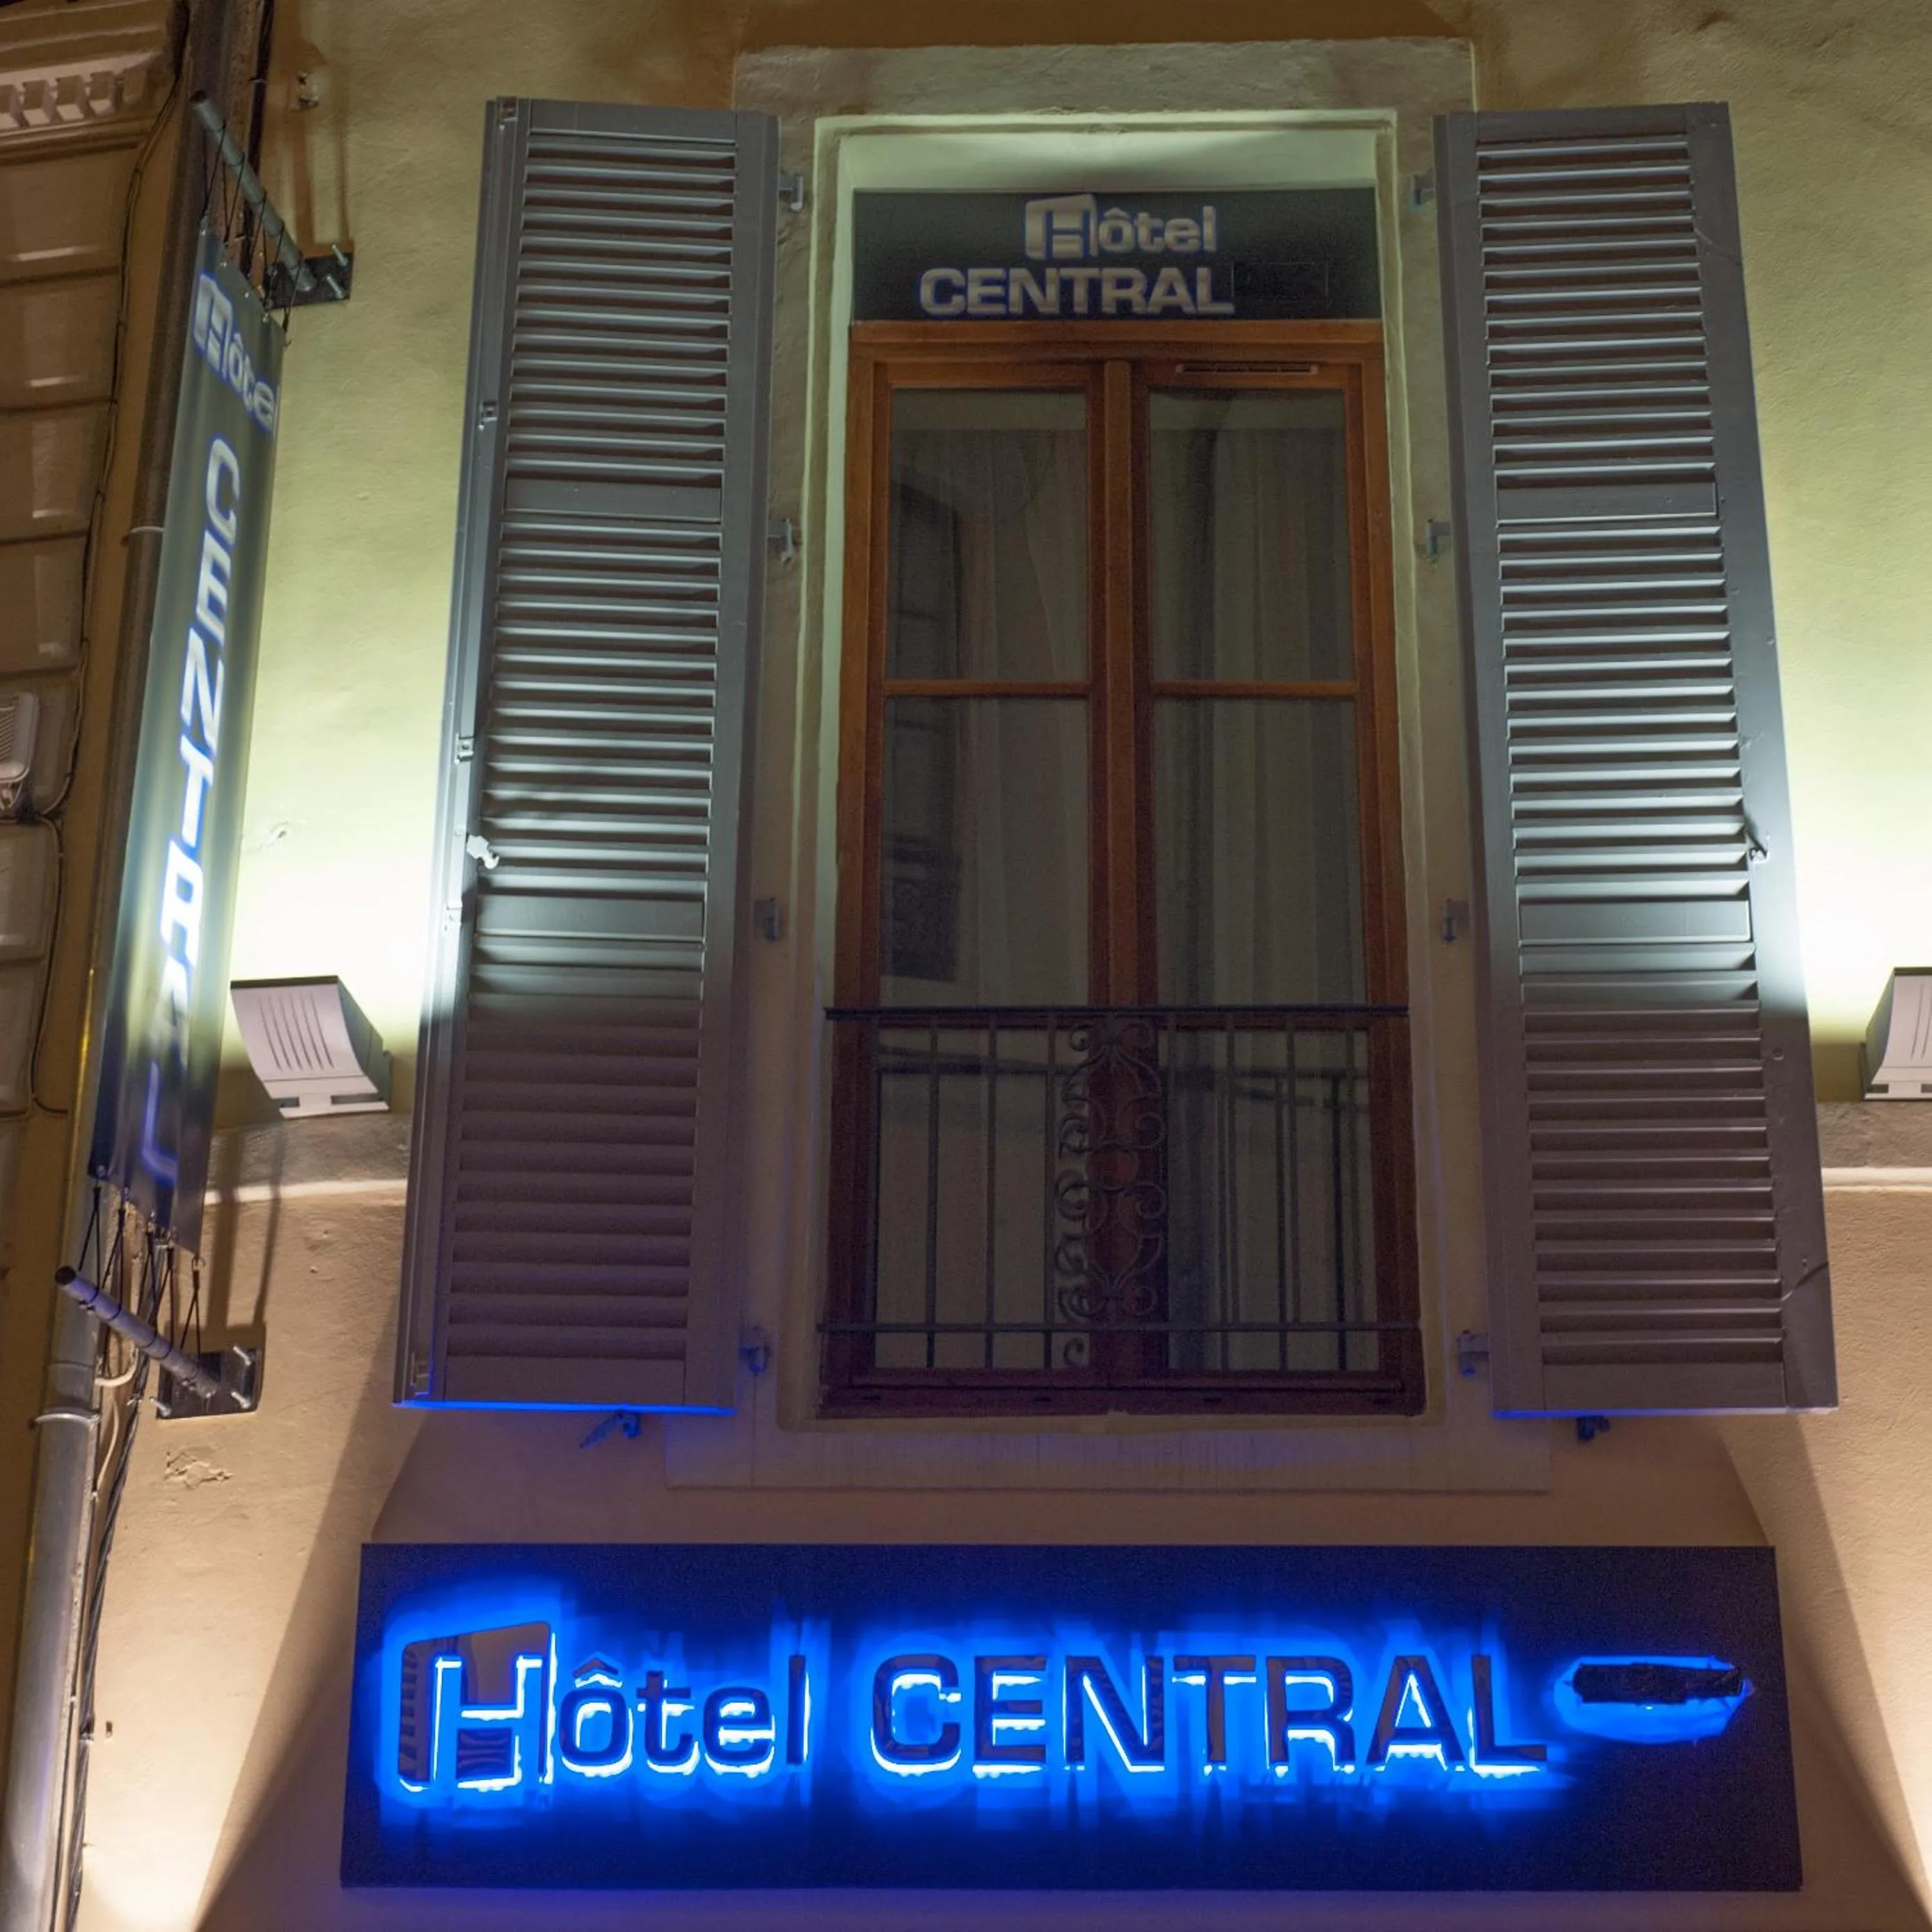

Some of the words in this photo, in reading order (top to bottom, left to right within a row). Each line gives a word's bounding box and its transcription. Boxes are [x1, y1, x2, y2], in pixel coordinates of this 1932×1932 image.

[919, 267, 1235, 315] CENTRAL
[1024, 193, 1217, 259] Hôtel
[194, 273, 276, 432] Hôte
[142, 438, 240, 1184] CENTRAL
[398, 1620, 811, 1792] Hôtel
[870, 1652, 1549, 1776] CENTRAL
